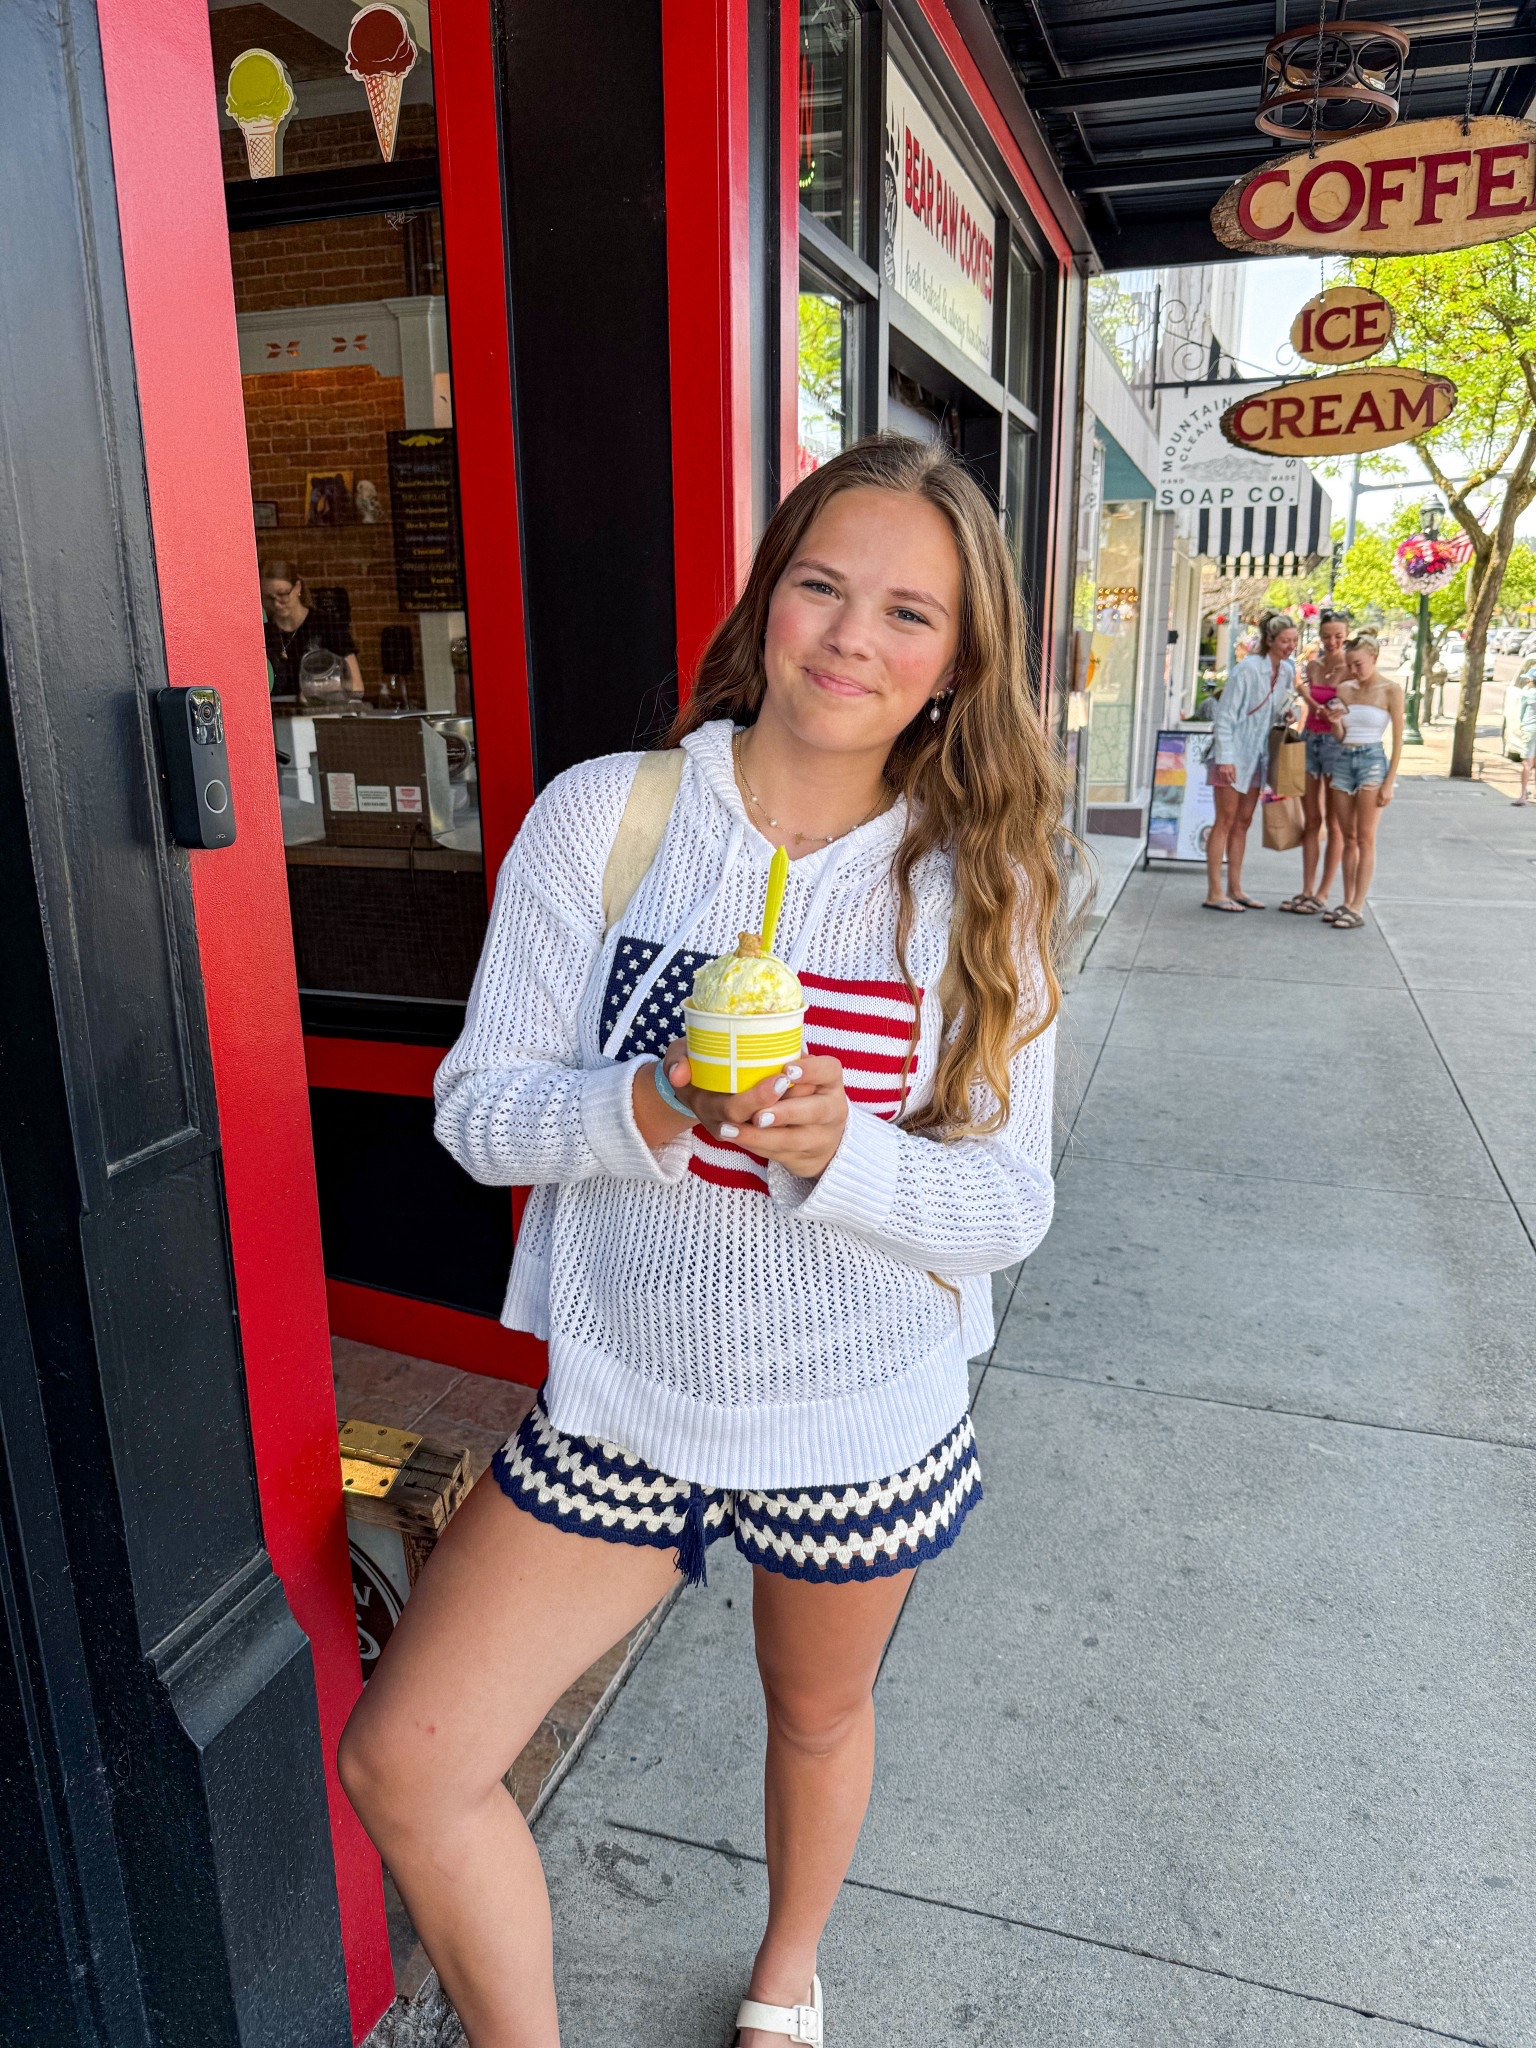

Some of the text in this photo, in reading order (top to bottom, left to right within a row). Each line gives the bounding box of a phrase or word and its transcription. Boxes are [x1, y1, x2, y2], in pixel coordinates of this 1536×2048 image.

[905, 125, 993, 305] BEAR PAW COOKIES
[1239, 142, 1536, 241] COFFE
[1300, 301, 1386, 353] ICE
[1162, 397, 1232, 472] MOUNTAIN
[1180, 421, 1213, 462] CLEAN
[1233, 385, 1451, 442] CREAM
[1161, 486, 1294, 505] SOAP CO.
